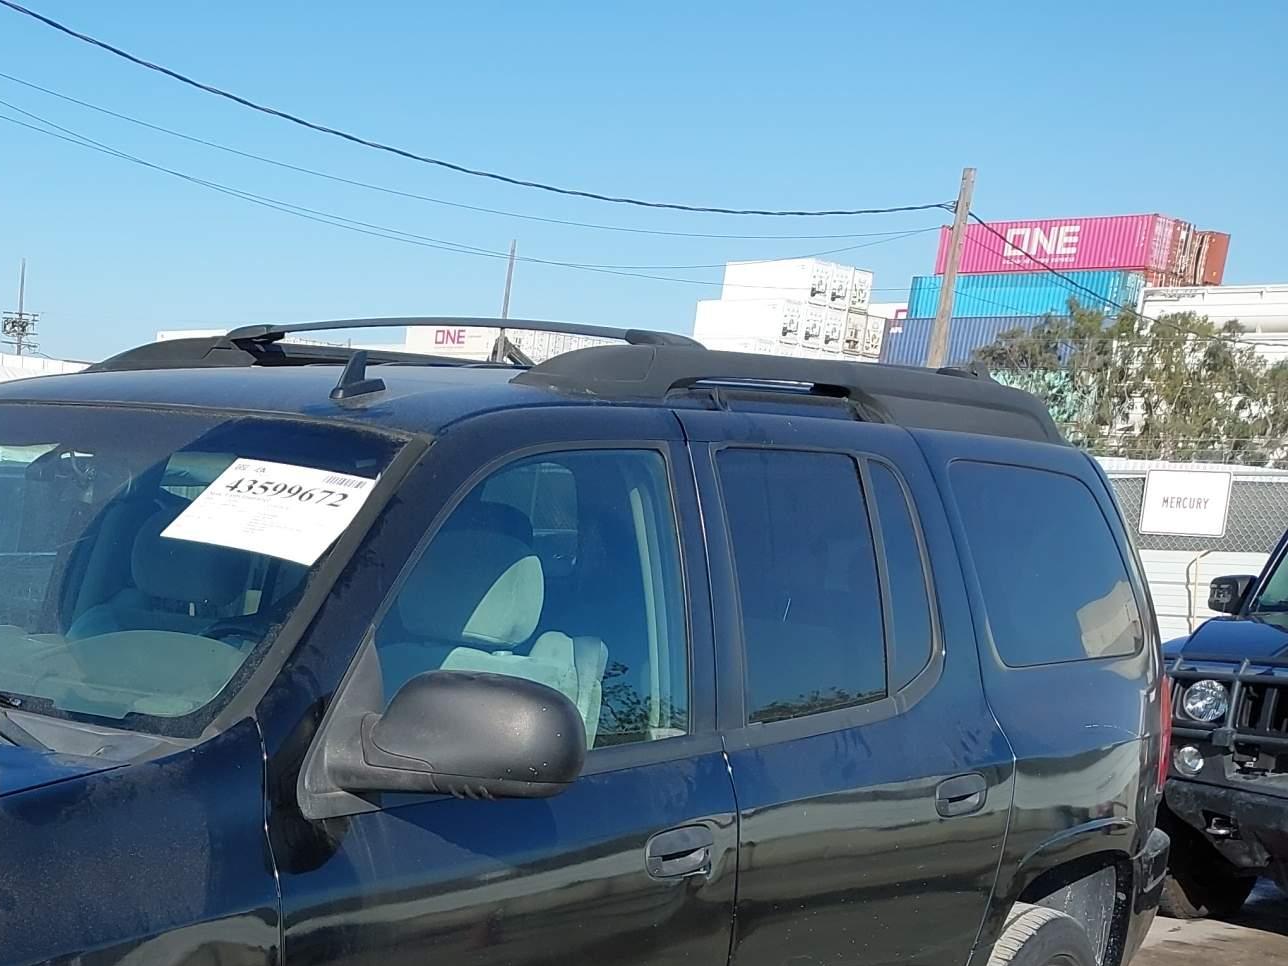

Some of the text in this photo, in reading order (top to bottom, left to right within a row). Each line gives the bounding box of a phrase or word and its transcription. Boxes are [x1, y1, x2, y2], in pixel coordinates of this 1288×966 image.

[1004, 226, 1080, 257] ONE
[435, 329, 466, 344] ONE
[225, 478, 349, 507] 43599672
[1161, 496, 1210, 510] MERCURY
